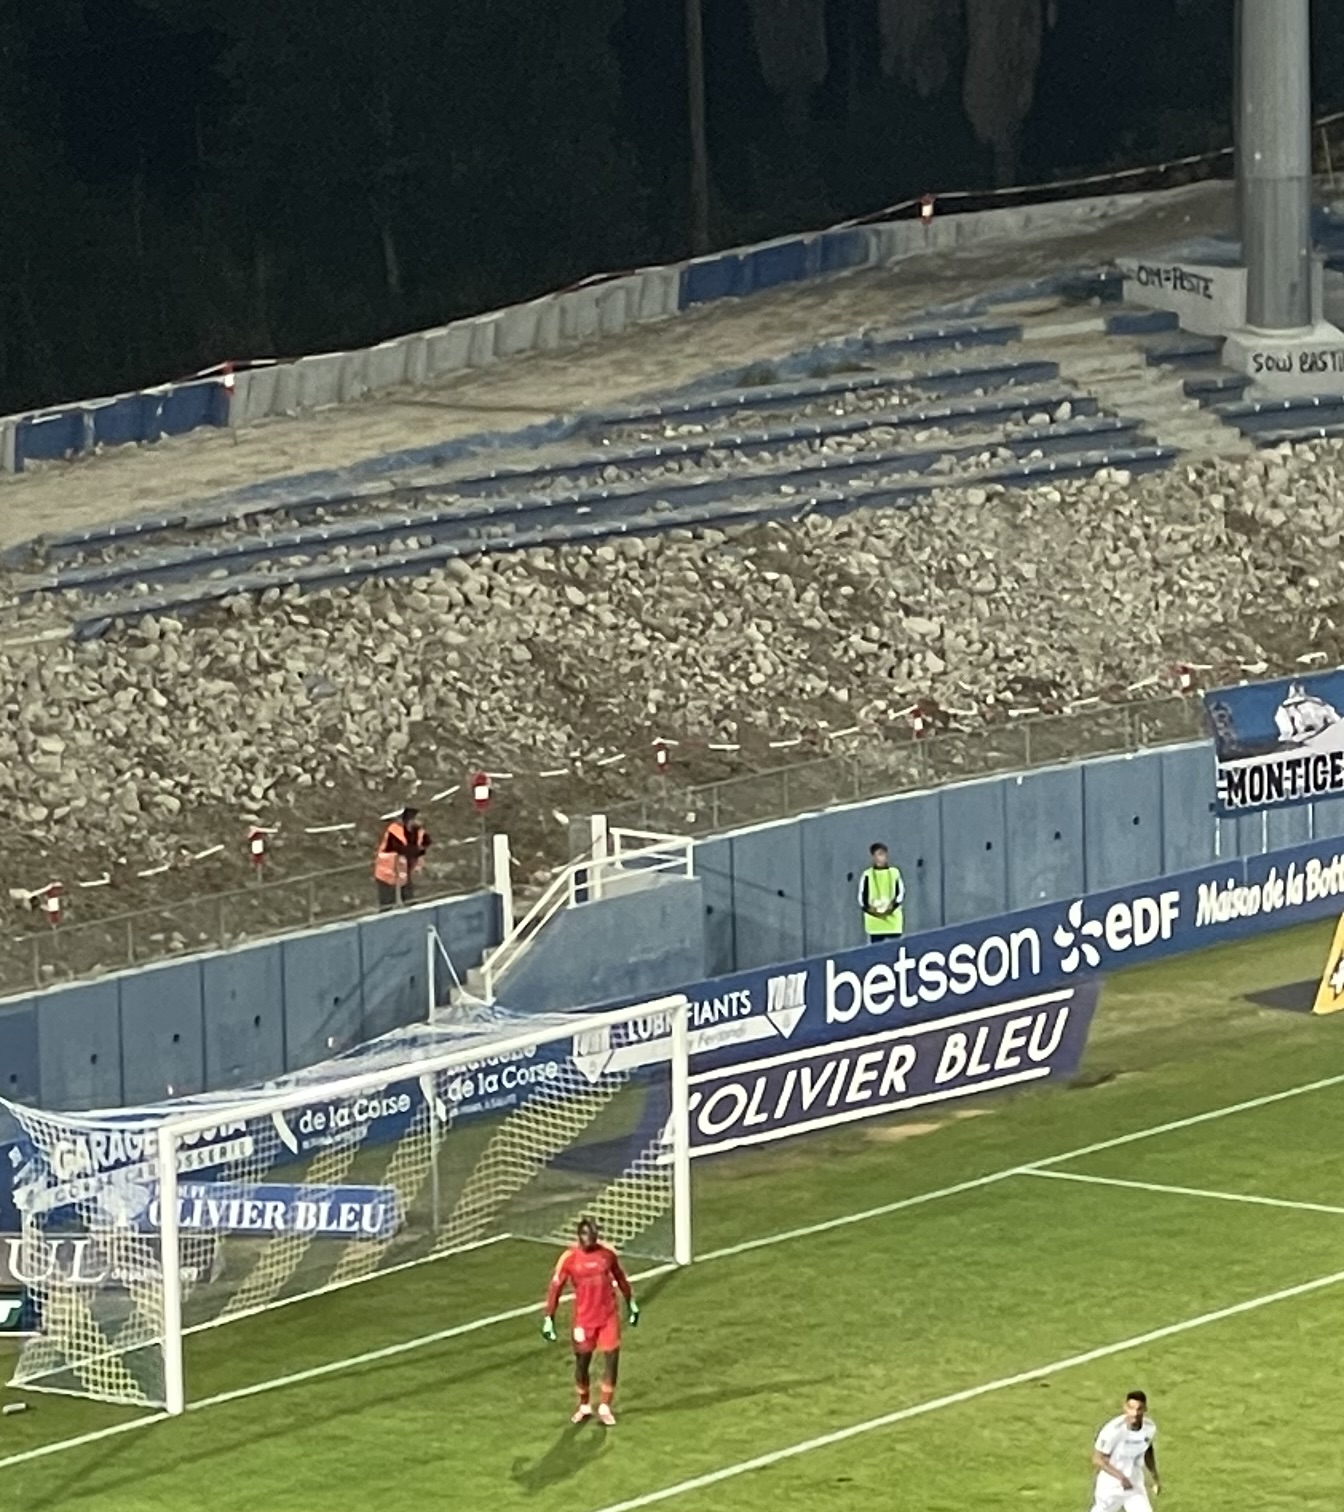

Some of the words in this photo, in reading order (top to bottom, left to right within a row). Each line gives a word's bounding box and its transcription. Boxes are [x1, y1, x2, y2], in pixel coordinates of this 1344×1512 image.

[1195, 877, 1261, 928] Maison
[1262, 866, 1285, 913] de
[1286, 861, 1305, 906] la
[826, 926, 1040, 1024] betsson
[934, 1006, 1071, 1086] BLEU
[502, 1061, 557, 1089] Corse
[353, 1093, 411, 1121] Corse
[295, 1201, 386, 1233] BLEU
